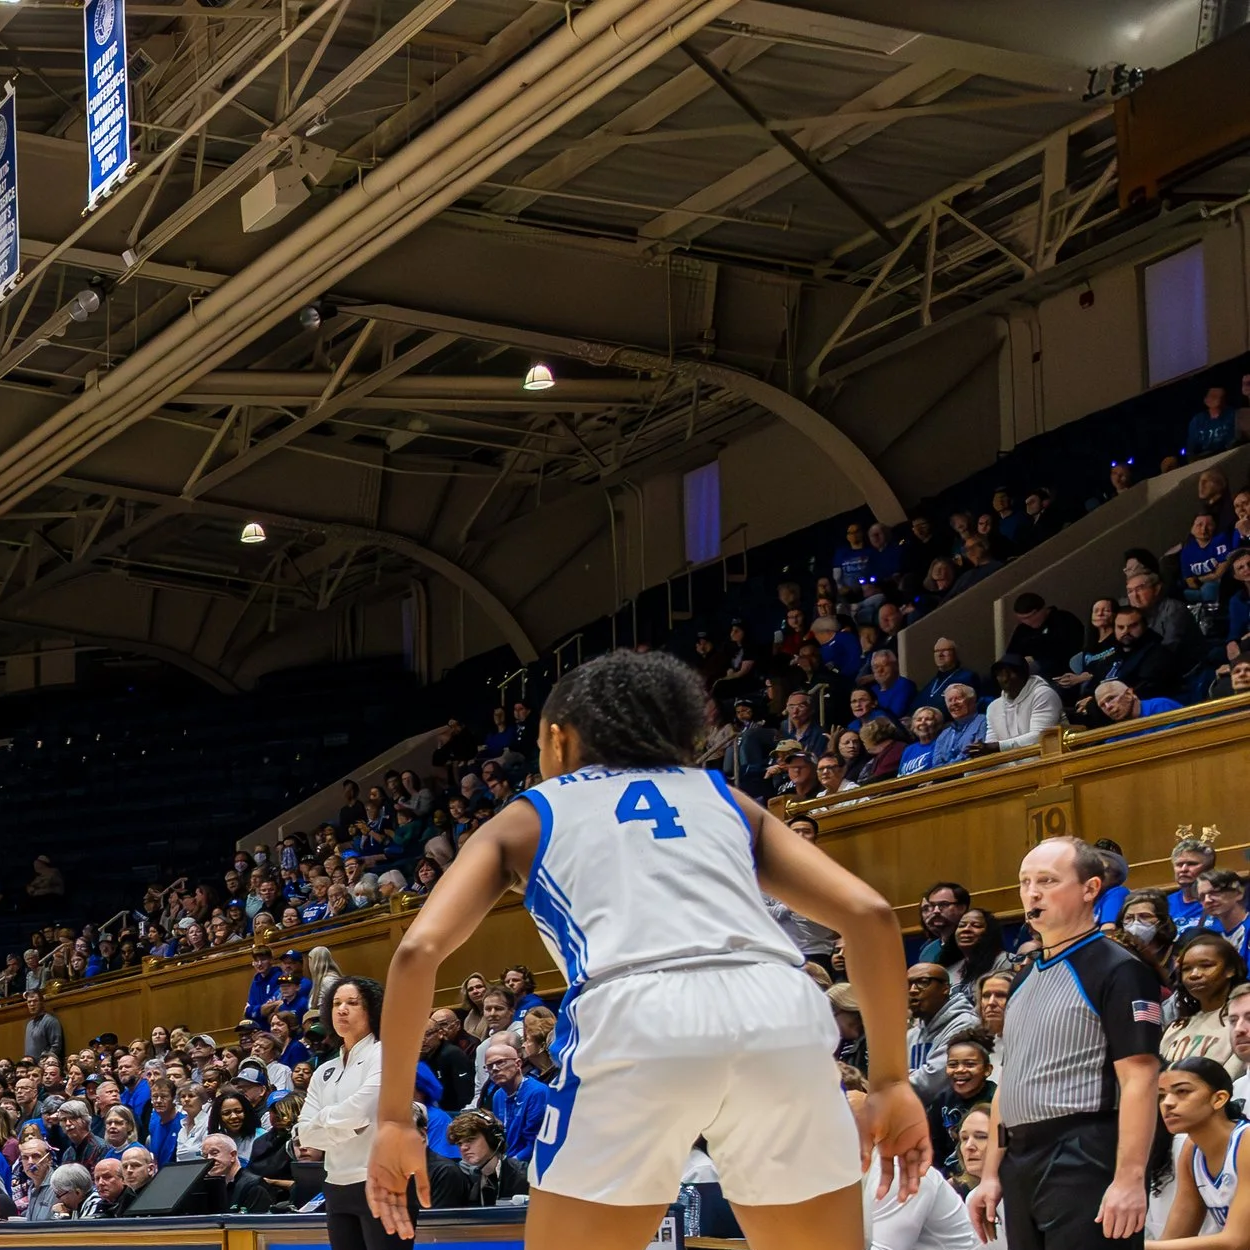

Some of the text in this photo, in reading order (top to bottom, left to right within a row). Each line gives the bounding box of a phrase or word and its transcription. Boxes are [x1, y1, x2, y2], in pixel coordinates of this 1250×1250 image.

[97, 61, 115, 89] COAST
[615, 779, 687, 839] 4
[1031, 807, 1066, 839] 19
